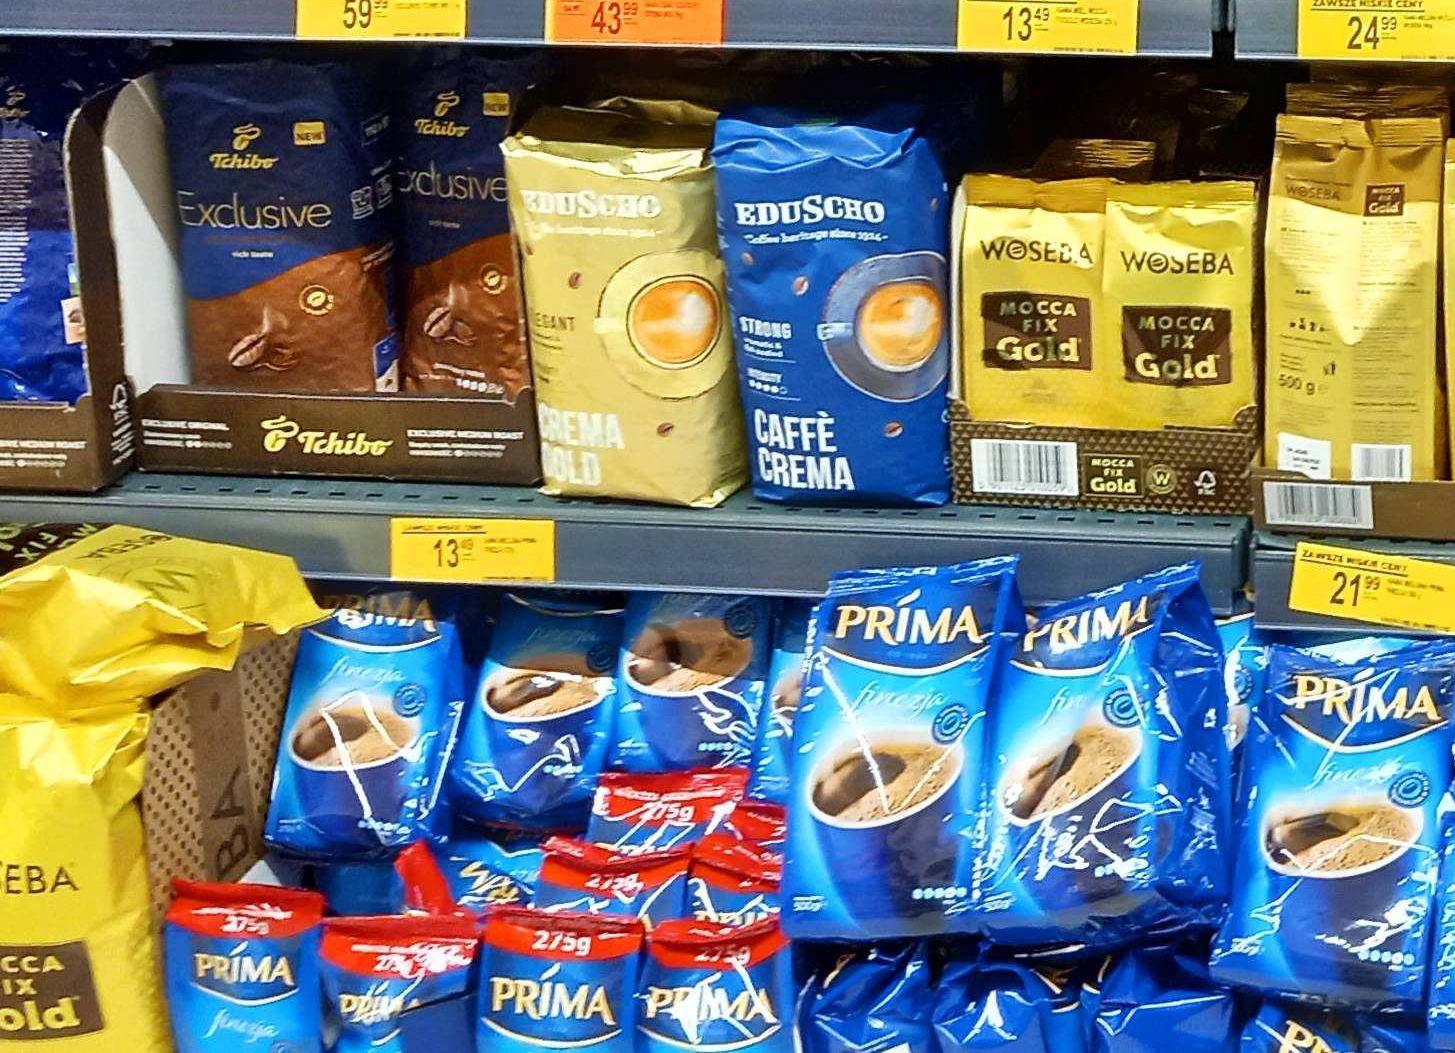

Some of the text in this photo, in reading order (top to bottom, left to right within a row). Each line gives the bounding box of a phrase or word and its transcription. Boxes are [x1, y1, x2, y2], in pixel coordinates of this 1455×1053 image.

[592, 2, 620, 34] 43
[1002, 7, 1032, 41] 13
[1034, 8, 1050, 21] 49
[1347, 16, 1379, 49] 24
[1382, 17, 1397, 30] 99
[415, 119, 469, 138] Tchibo
[210, 153, 278, 170] Tchibo
[179, 192, 332, 229] Exclusive
[735, 195, 885, 226] EDUSCHO
[980, 240, 1093, 269] WOSEBA
[1120, 250, 1234, 275] WOSEBA
[1000, 300, 1077, 318] MOCCA
[740, 316, 792, 340] STRONG
[1023, 318, 1058, 333] FIX
[1140, 315, 1215, 332] MOCCA
[997, 337, 1081, 363] Gold
[1161, 333, 1195, 349] FIX
[1135, 352, 1218, 380] Gold
[753, 409, 837, 453] CAFFÈ
[298, 432, 393, 456] Tchibo
[758, 452, 855, 491] CREMA
[1091, 458, 1135, 468] MOCCA
[1091, 476, 1136, 493] Gold
[1331, 572, 1360, 606] 21
[532, 932, 590, 955] 275g
